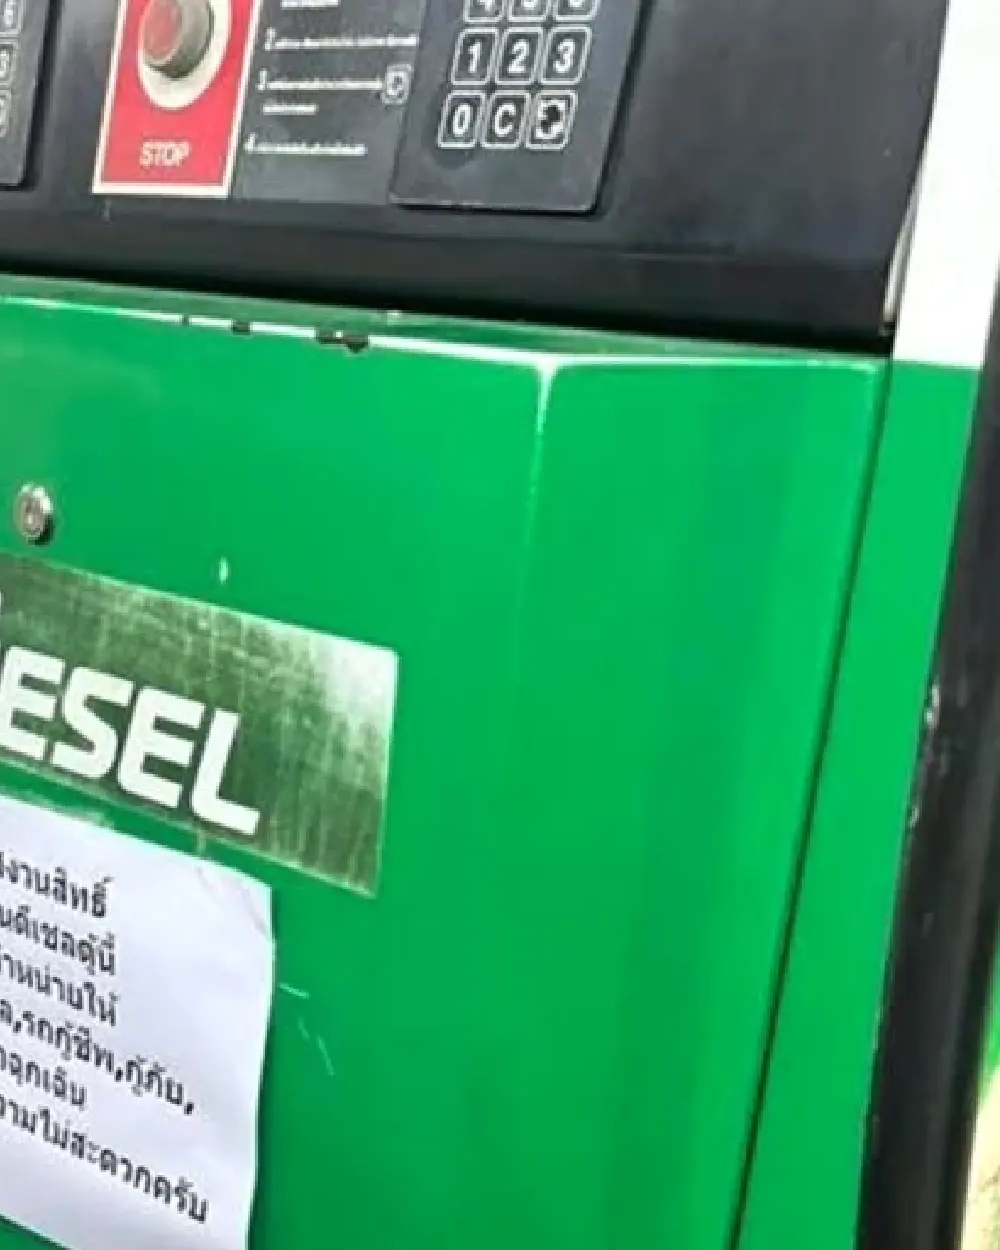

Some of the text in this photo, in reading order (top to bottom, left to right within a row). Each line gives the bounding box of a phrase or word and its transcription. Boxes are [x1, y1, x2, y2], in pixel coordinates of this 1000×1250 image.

[468, 38, 576, 74] 1 2 3
[454, 103, 517, 138] 0 C
[139, 141, 191, 168] STOP
